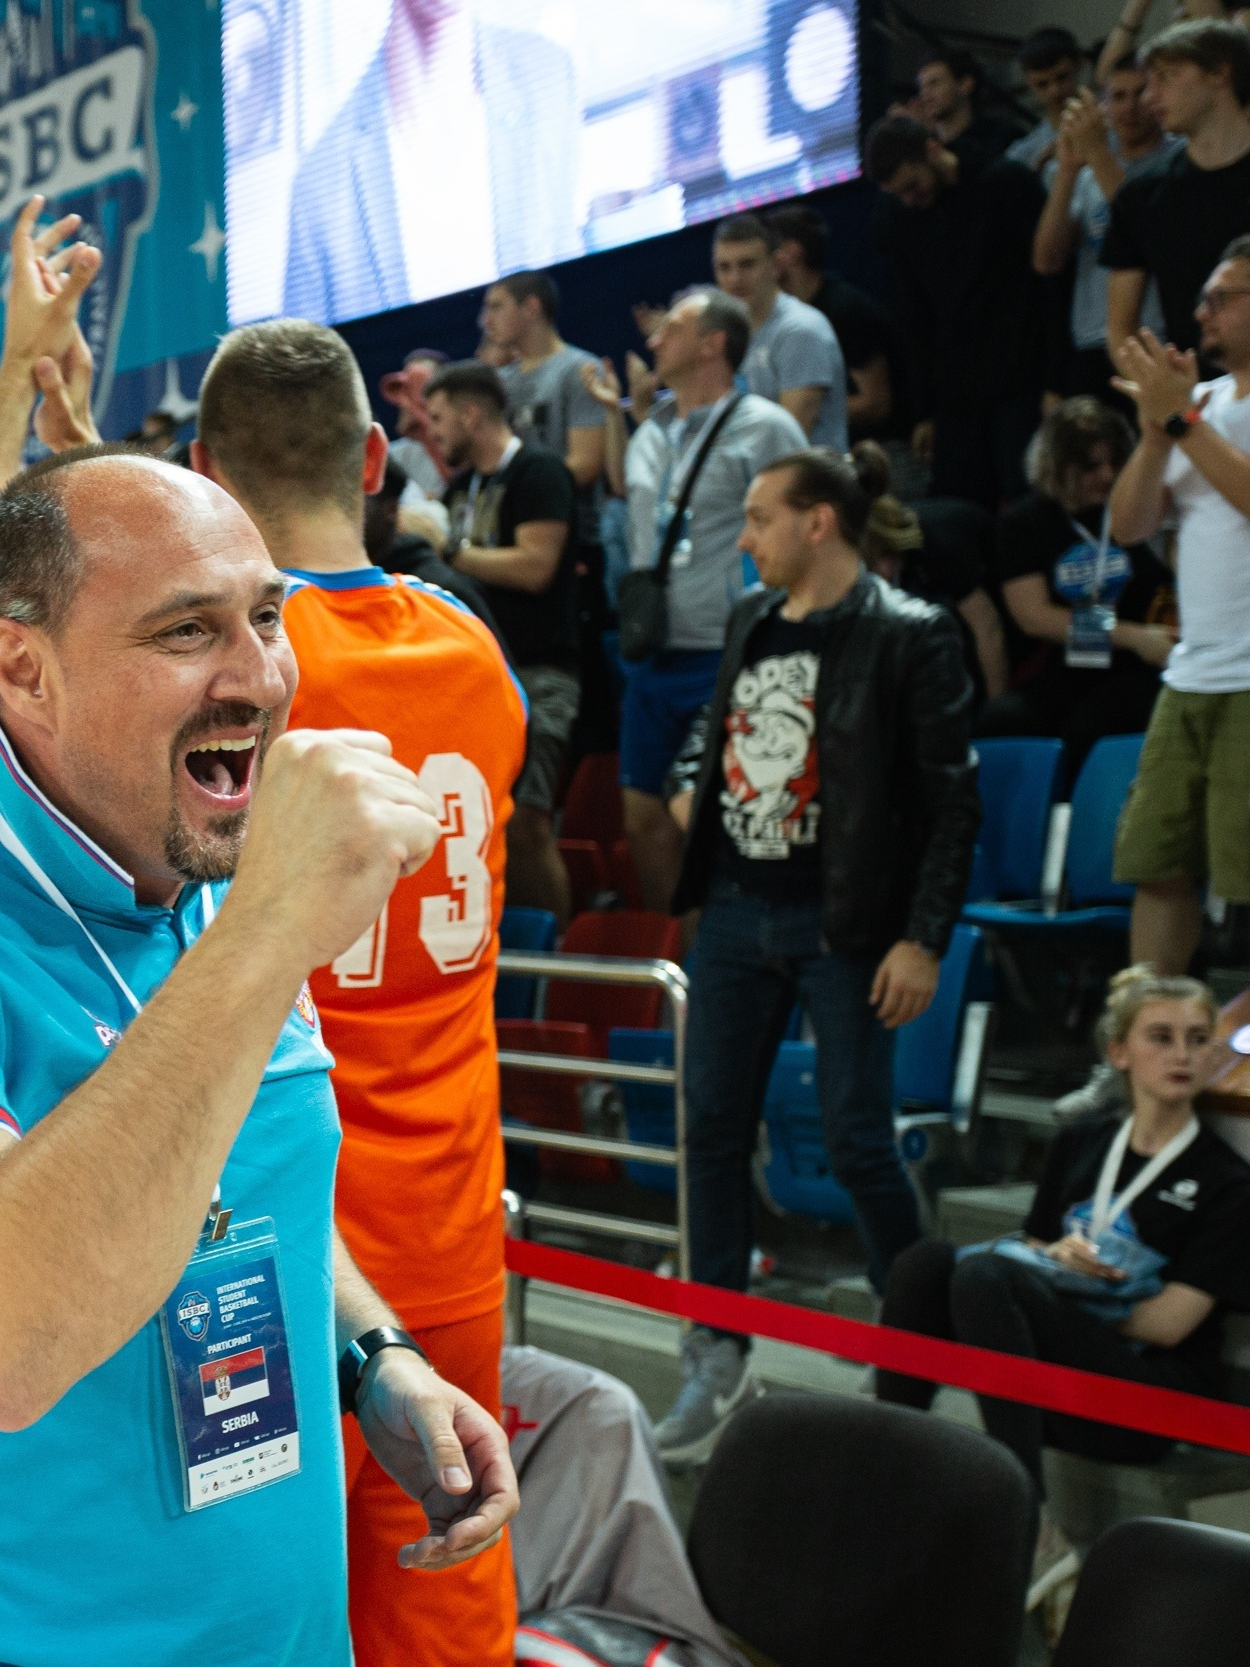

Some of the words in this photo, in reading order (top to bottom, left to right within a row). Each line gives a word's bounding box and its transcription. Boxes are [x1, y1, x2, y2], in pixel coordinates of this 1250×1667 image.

[216, 1274, 266, 1295] INTERNATIONAL
[218, 1289, 247, 1305] STUDENT
[219, 1296, 259, 1314] BASKETBALL
[182, 1304, 206, 1318] ISBC
[221, 1312, 235, 1323] CUP
[207, 1333, 252, 1354] PARTICIPANT
[221, 1410, 260, 1434] SERBIA
